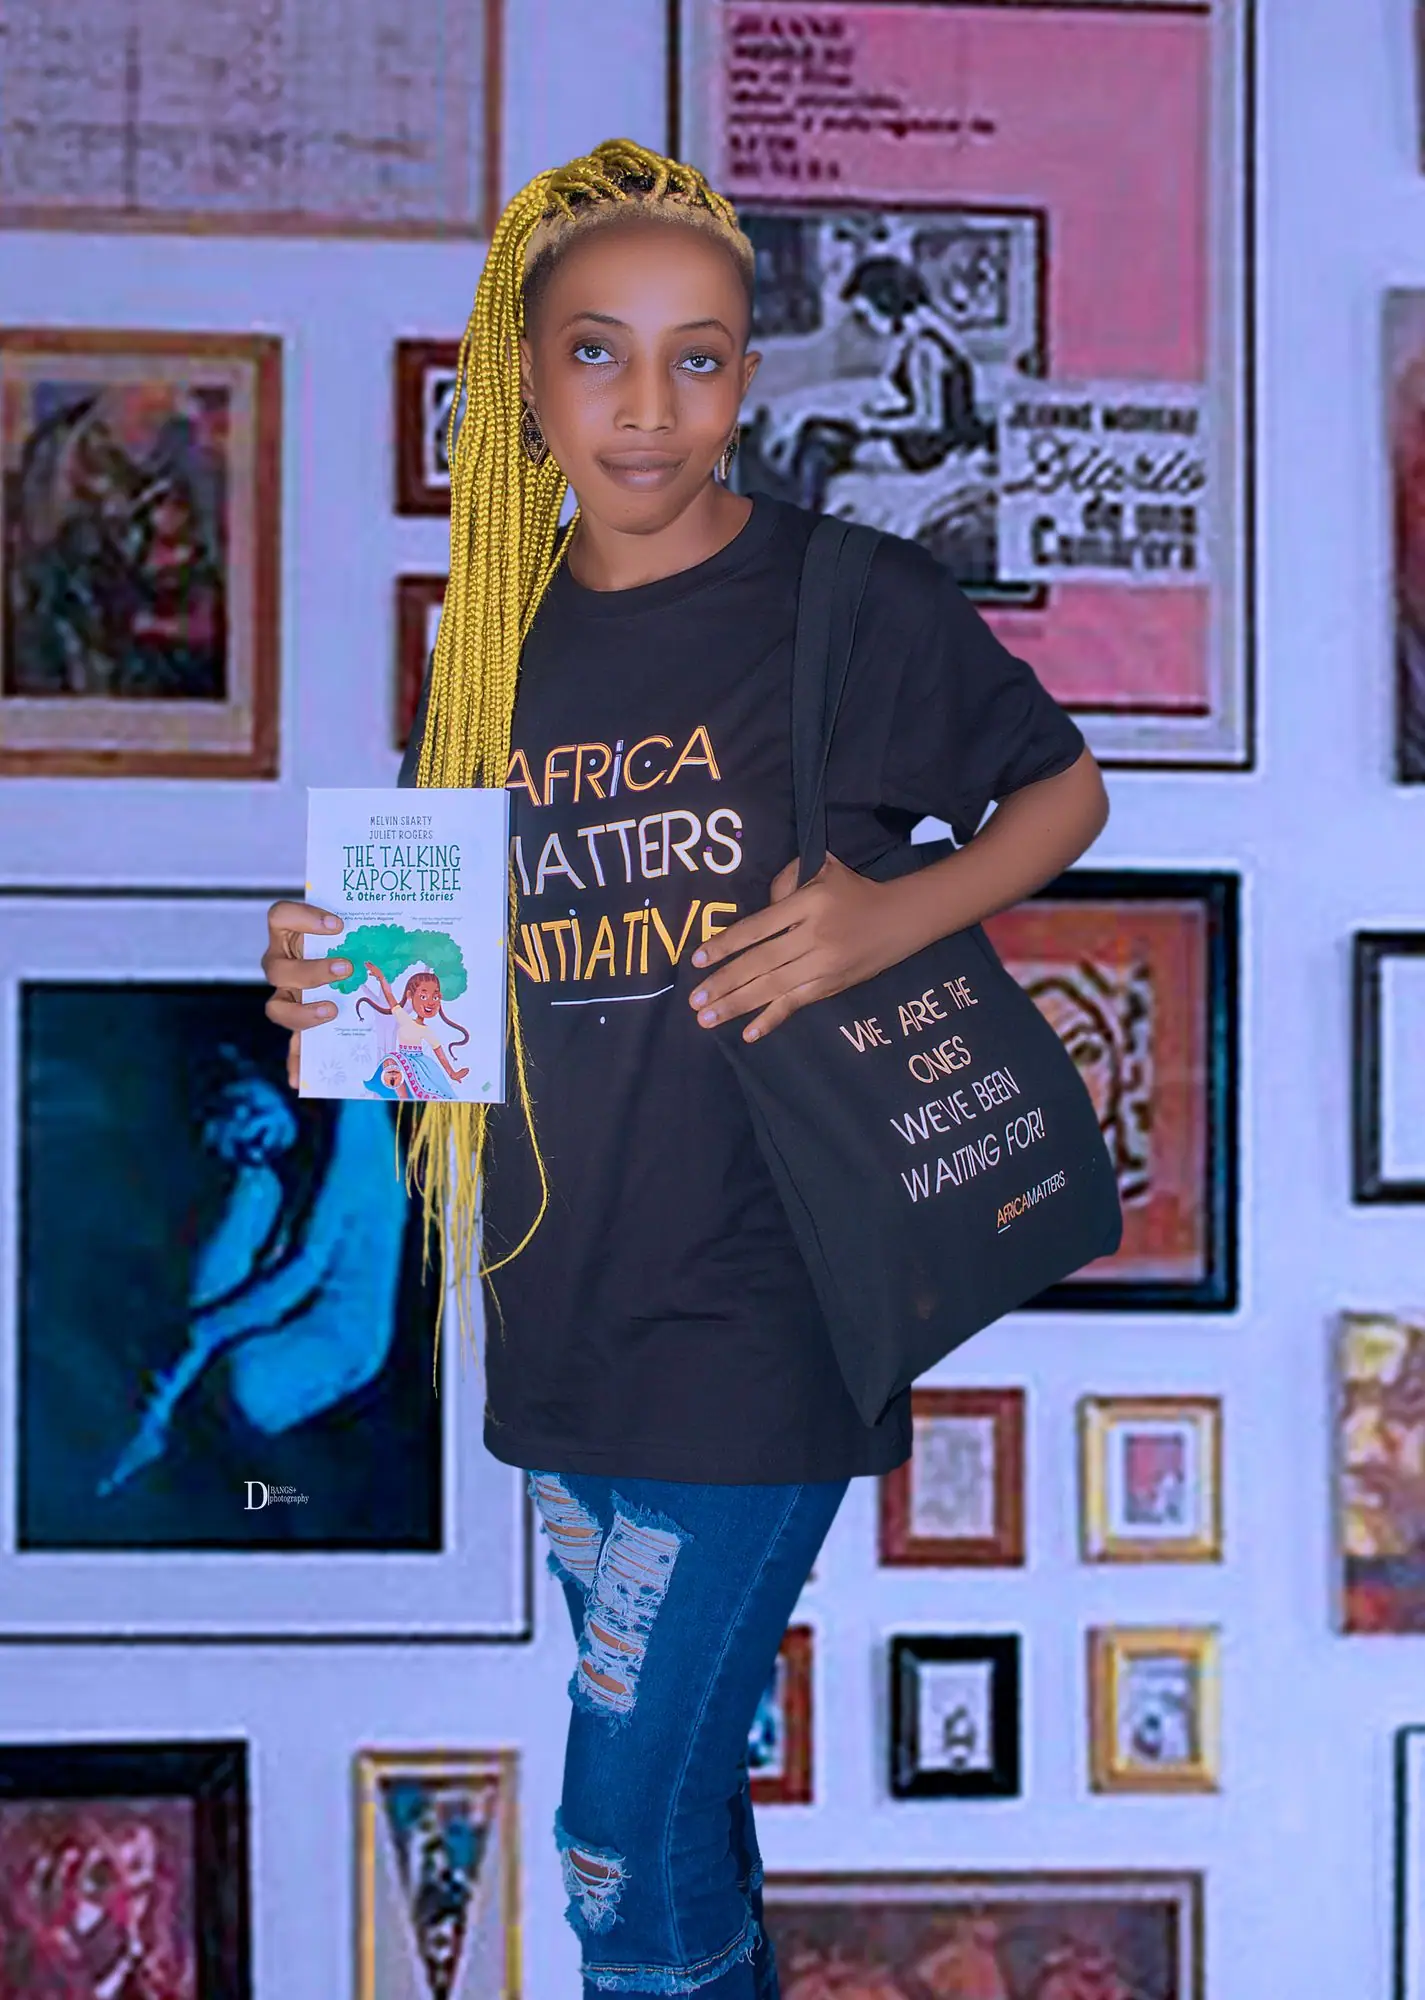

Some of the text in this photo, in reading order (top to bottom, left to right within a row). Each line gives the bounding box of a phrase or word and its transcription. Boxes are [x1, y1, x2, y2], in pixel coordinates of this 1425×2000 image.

[369, 830, 434, 840] JULIET ROGERS
[370, 815, 398, 826] MELVIN
[342, 844, 461, 868] THE TALKING
[511, 808, 743, 896] ATTERS
[342, 867, 462, 891] KAPOK TREE
[346, 891, 454, 902] & Other Short Stories
[839, 975, 979, 1053] WE ARE THE
[908, 1035, 973, 1084] ONES
[890, 1066, 1021, 1145] WE'VE BEEN
[900, 1107, 1046, 1203] WAITING FOR!
